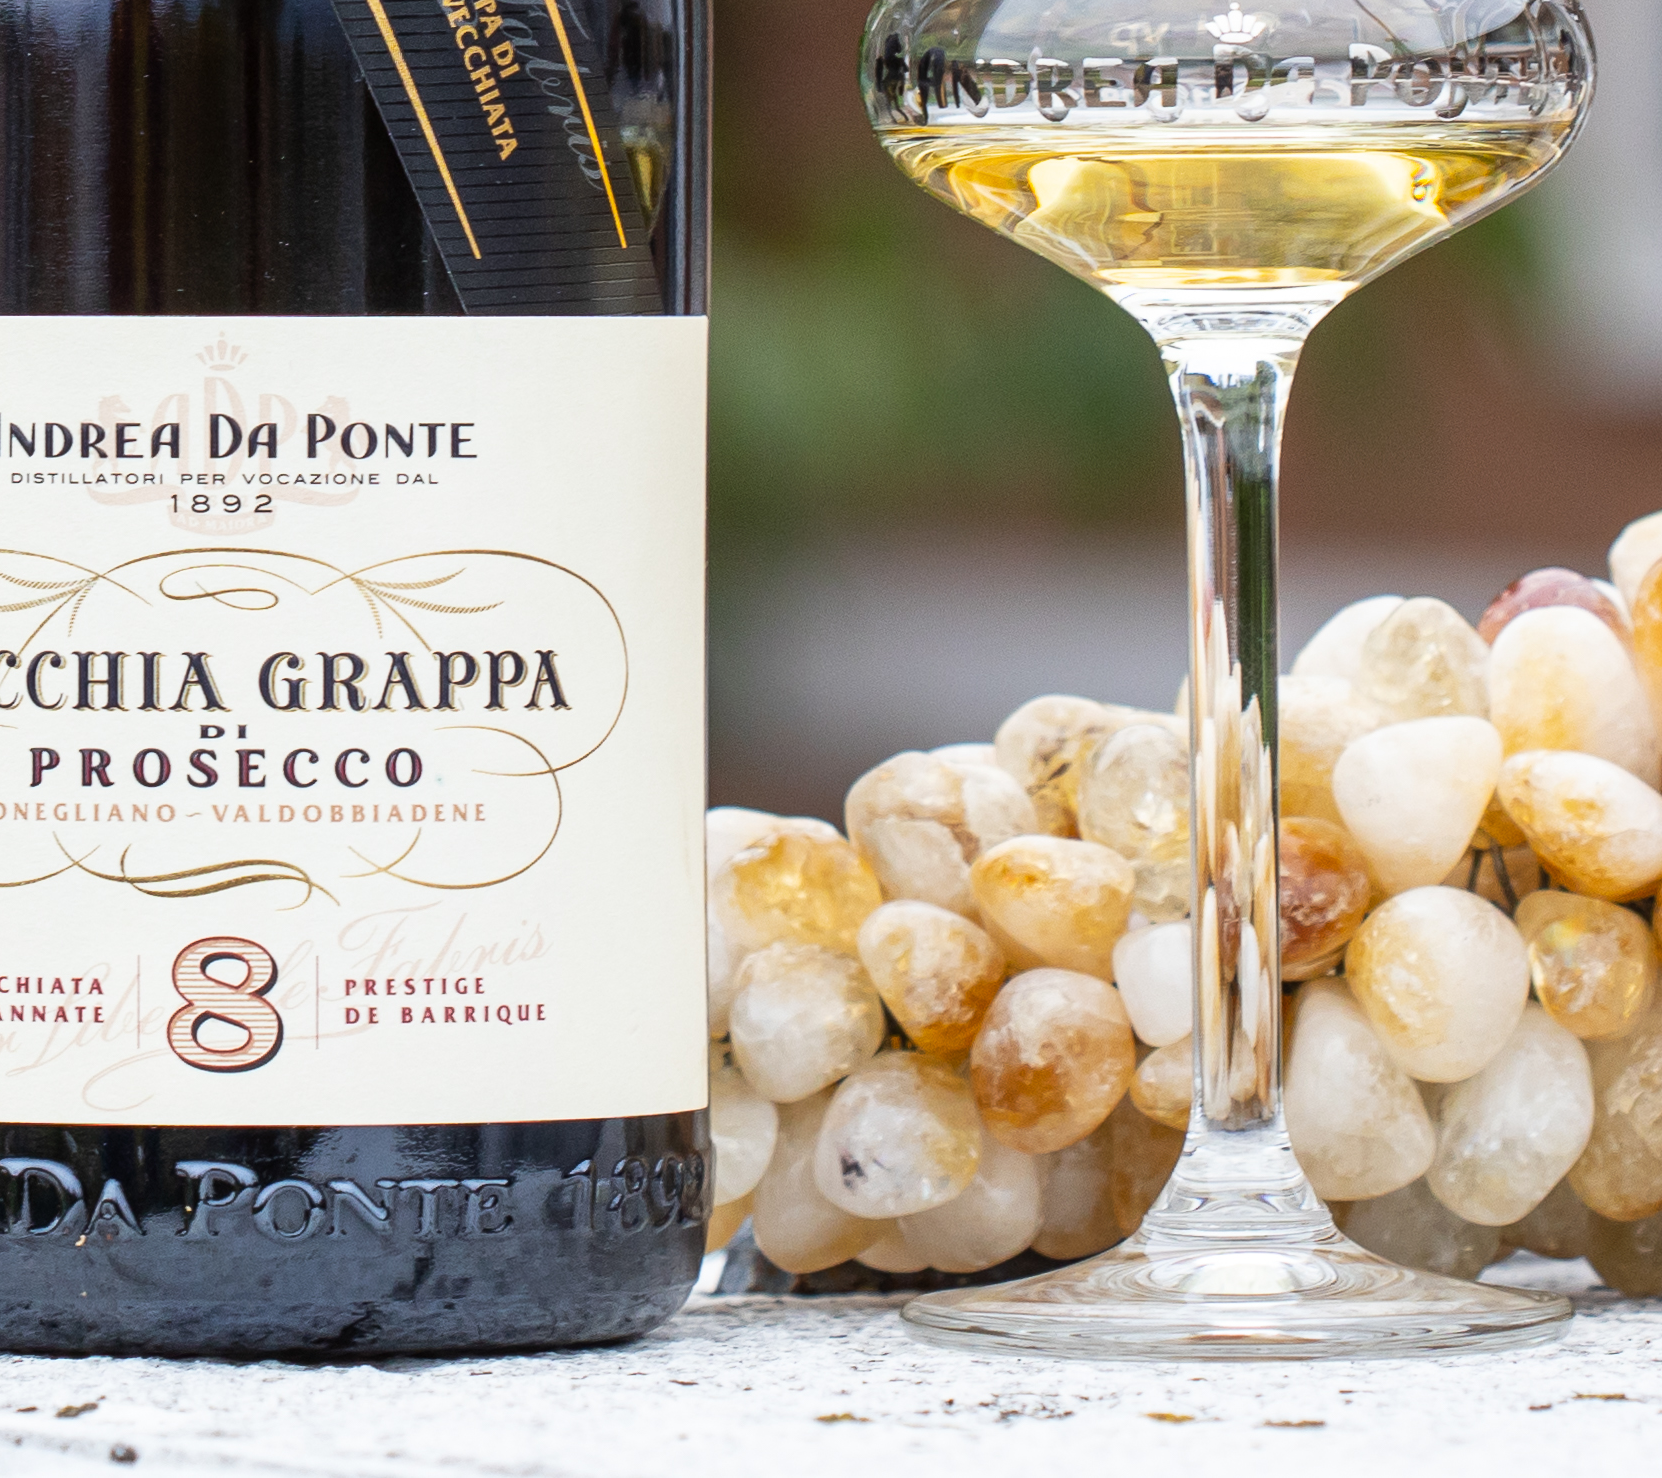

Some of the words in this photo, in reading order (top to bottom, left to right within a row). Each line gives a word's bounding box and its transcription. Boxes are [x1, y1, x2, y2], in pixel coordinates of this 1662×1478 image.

[492, 40, 520, 79] DI
[307, 413, 478, 460] PONTE
[10, 471, 164, 486] DISTILLATORI
[180, 472, 226, 486] PER
[241, 472, 381, 486] VOCAZIONE
[396, 472, 439, 486] DAL
[171, 493, 274, 514] 1892
[258, 649, 573, 713] GRAPPA
[199, 724, 248, 740] DI
[29, 746, 423, 789] PROSECCO
[212, 802, 486, 824] VALDOBBIADENE
[344, 976, 487, 997] PRESTIGE
[166, 935, 284, 1074] 8
[344, 1006, 381, 1025] DE
[400, 1002, 548, 1026] BARRIQUE
